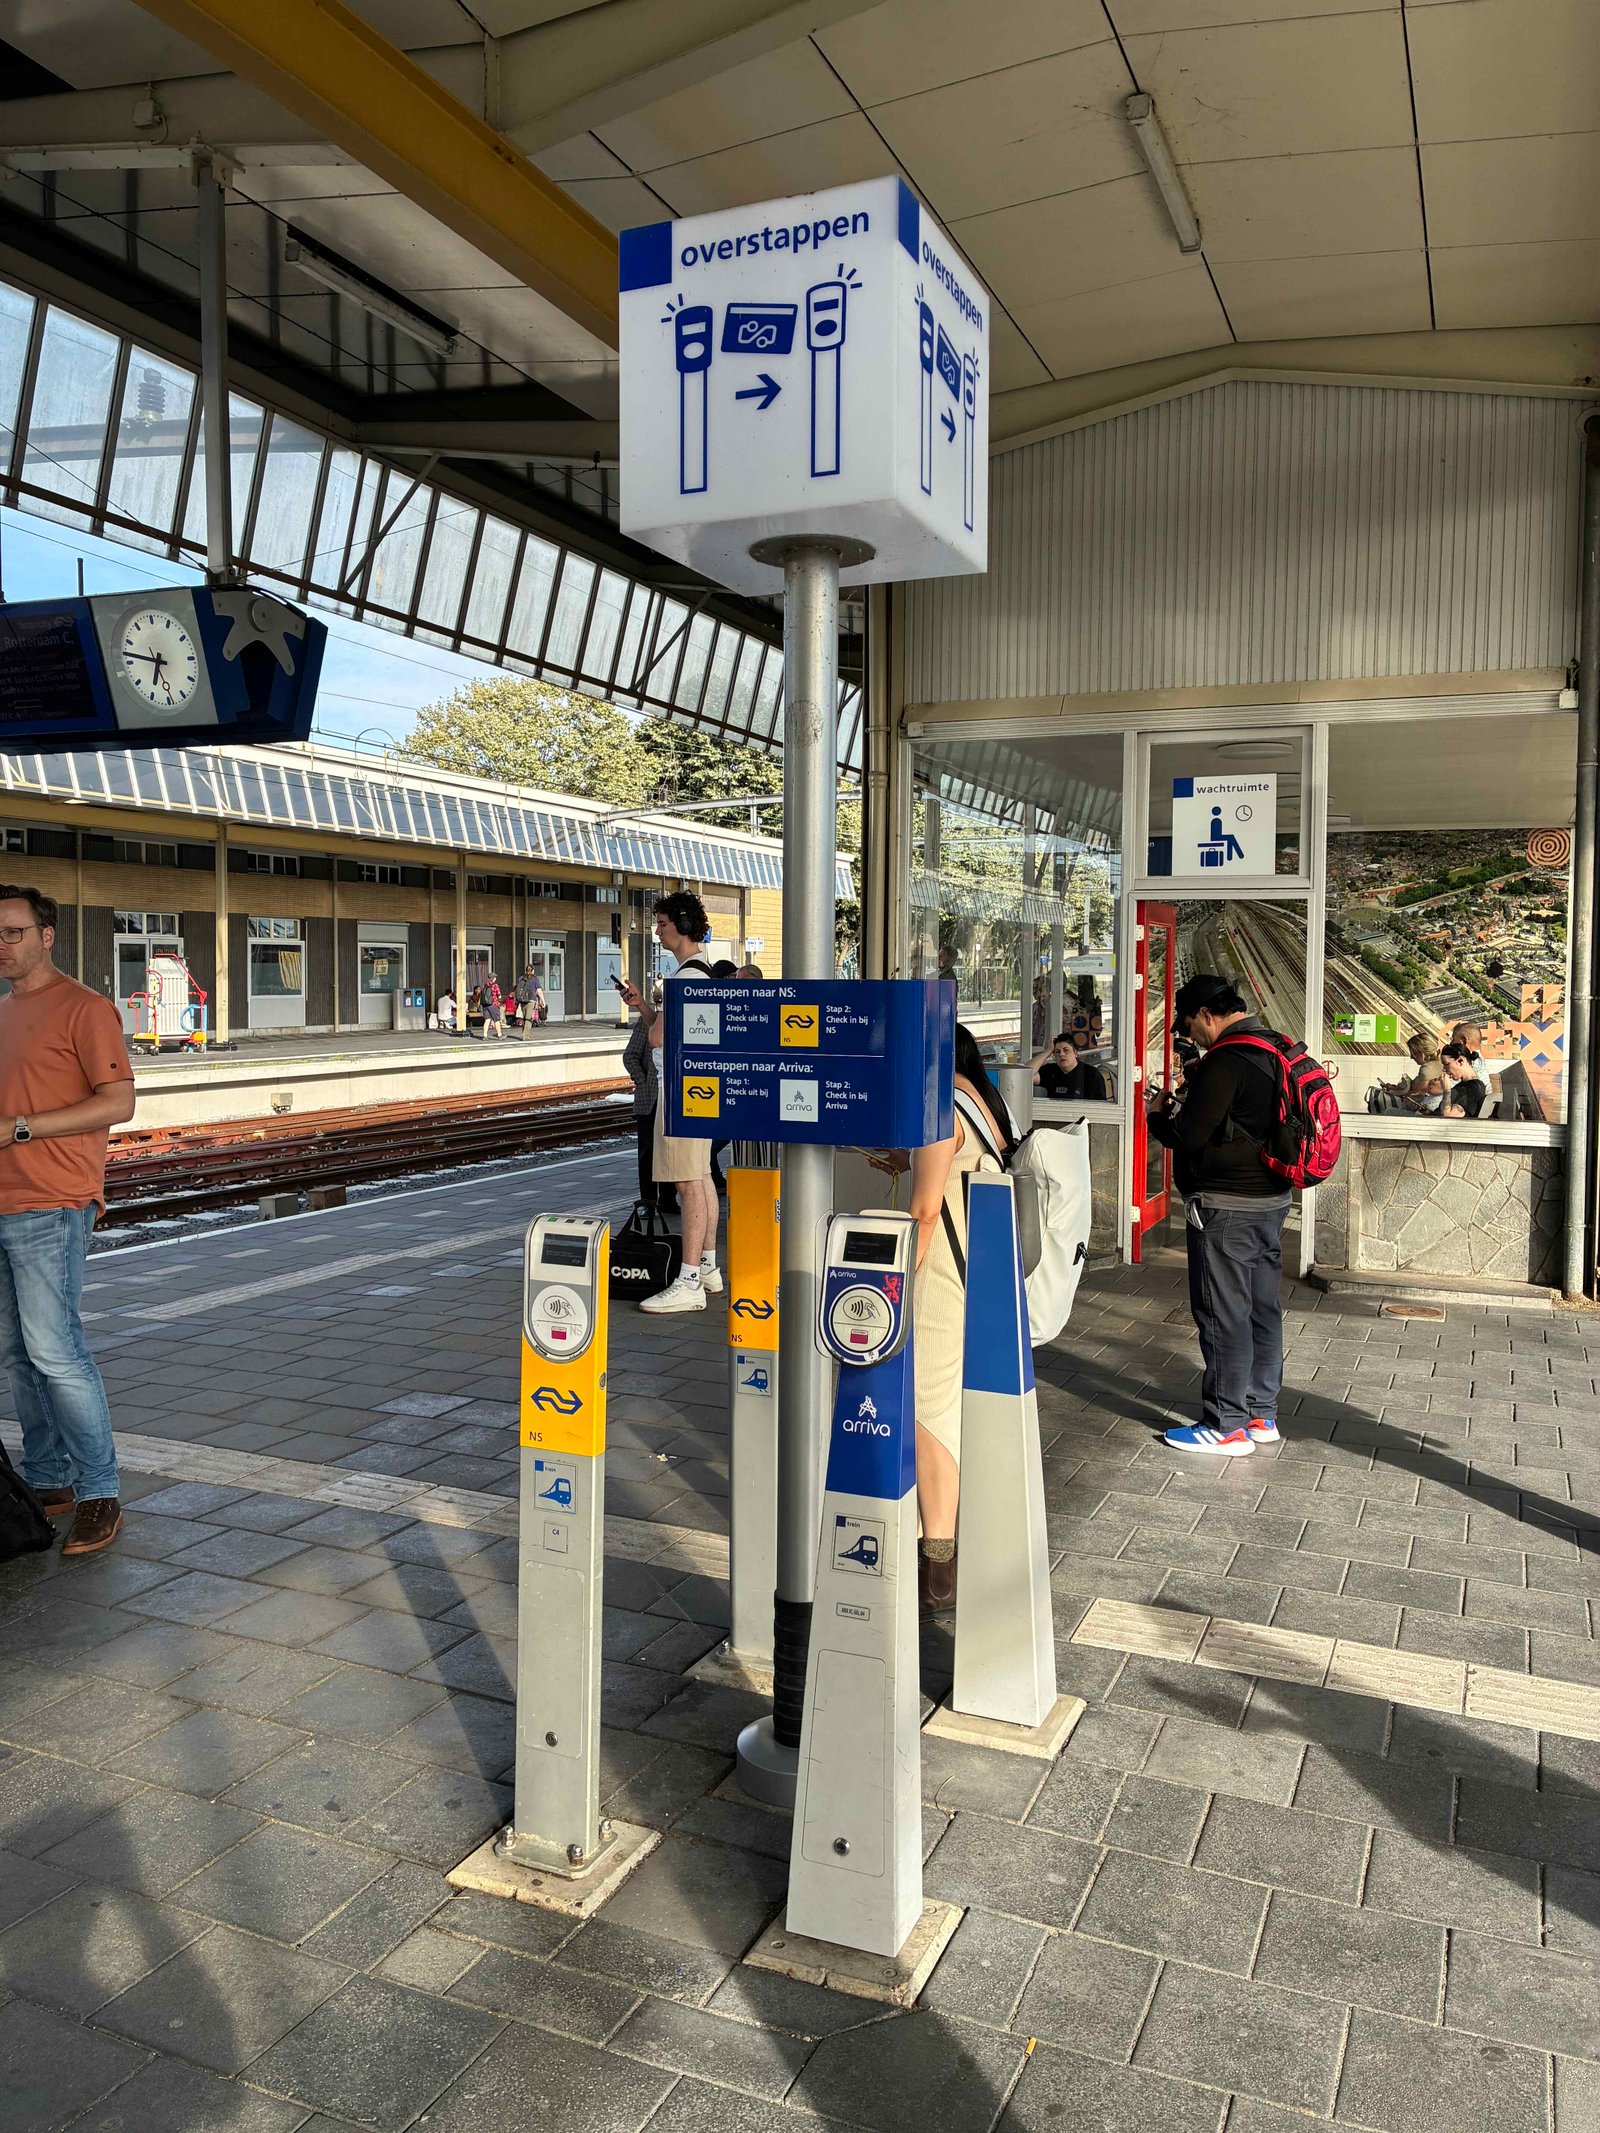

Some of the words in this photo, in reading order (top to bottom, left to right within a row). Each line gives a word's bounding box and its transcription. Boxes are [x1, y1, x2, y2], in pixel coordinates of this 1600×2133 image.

[680, 211, 870, 268] overstappen
[922, 240, 983, 332] overstappen
[1196, 783, 1269, 794] wachtruimte
[683, 986, 749, 999] Overstappen
[752, 989, 776, 997] naar
[778, 986, 796, 998] NS:
[725, 1003, 742, 1013] Stap
[743, 1004, 750, 1012] 1:
[825, 1005, 843, 1014] Stap
[844, 1005, 852, 1013] 2:
[725, 1014, 747, 1022] Check
[748, 1014, 759, 1022] uit
[759, 1014, 769, 1024] bij
[825, 1015, 848, 1024] Check
[849, 1016, 857, 1024] in
[858, 1016, 869, 1026] bij
[688, 1026, 715, 1035] arriva
[725, 1024, 747, 1032] Arriva
[825, 1026, 837, 1034] NS
[683, 1059, 749, 1073] Overstappen
[752, 1062, 776, 1072] naar
[778, 1062, 814, 1073] Arriva:
[726, 1077, 742, 1087] Stap
[825, 1080, 843, 1090] Stap
[843, 1081, 851, 1089] 2:
[725, 1087, 747, 1096] Check
[748, 1088, 759, 1096] uit
[759, 1088, 769, 1098] bij
[825, 1091, 848, 1099] Check
[848, 1091, 857, 1099] in
[858, 1092, 869, 1102] bij
[725, 1097, 737, 1106] NS
[825, 1101, 848, 1110] Arriva
[785, 1102, 813, 1112] arriva
[610, 1266, 651, 1281] COPA
[837, 1271, 858, 1279] arriva
[731, 1334, 743, 1343] NS
[842, 1418, 891, 1438] arriva
[529, 1431, 543, 1442] NS
